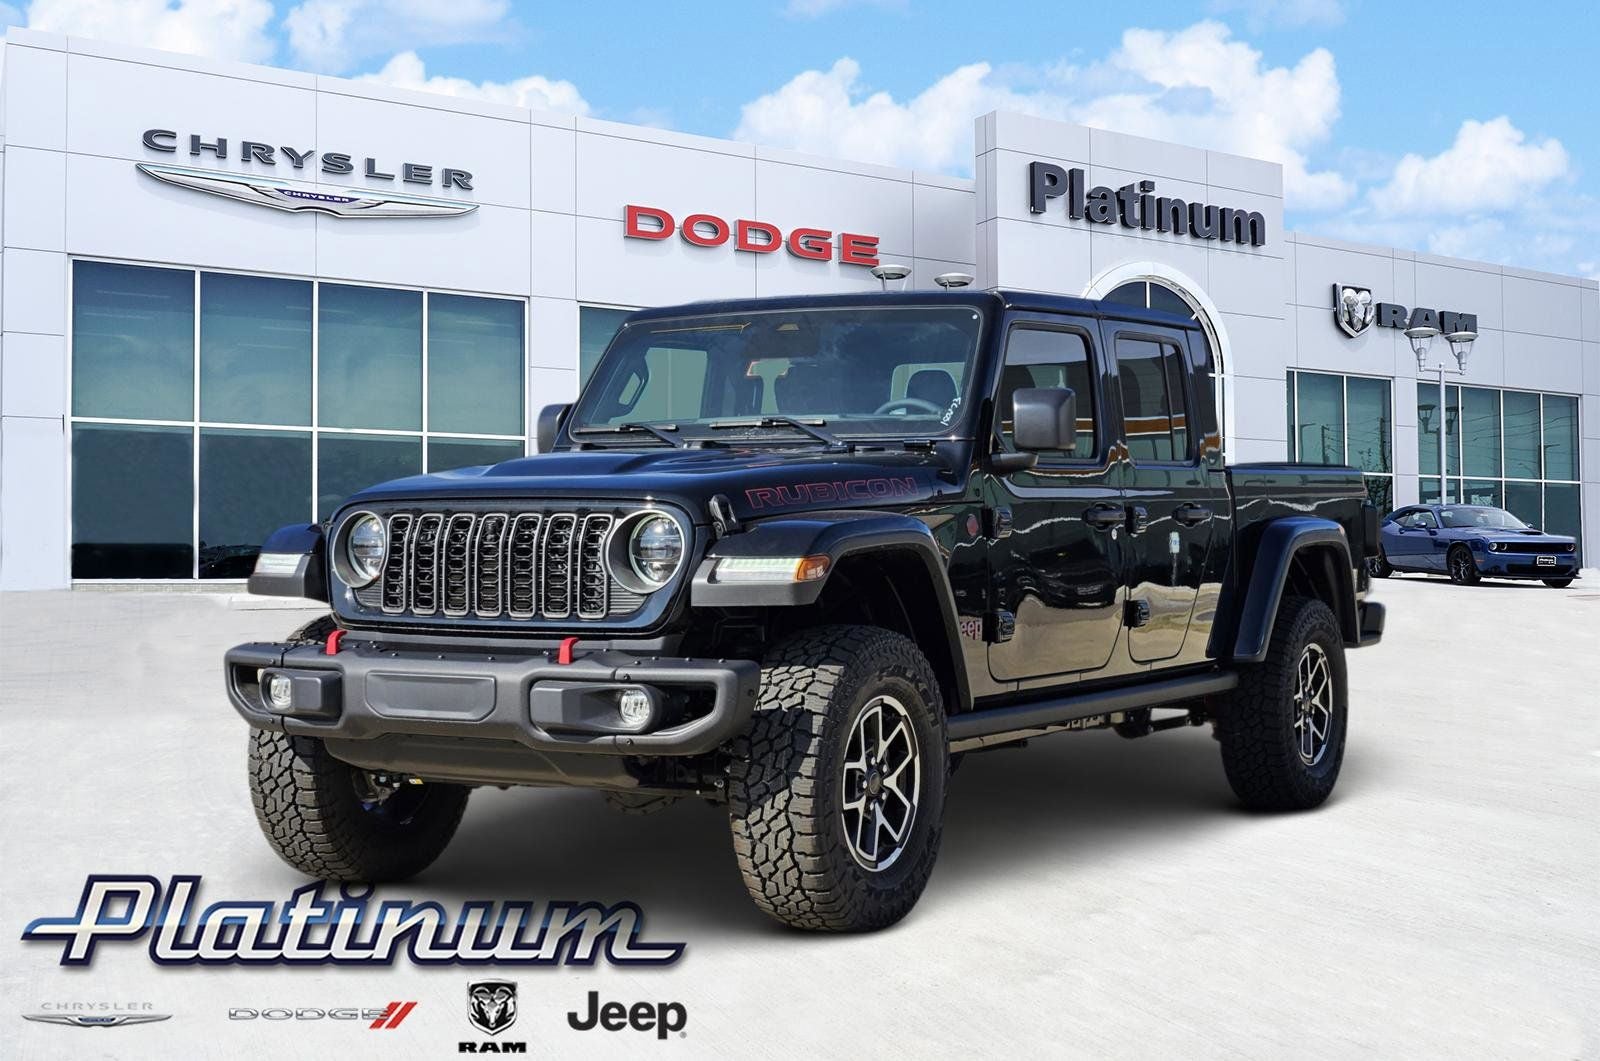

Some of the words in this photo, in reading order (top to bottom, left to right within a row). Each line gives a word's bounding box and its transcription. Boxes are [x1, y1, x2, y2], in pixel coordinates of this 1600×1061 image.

[142, 128, 474, 190] CHRYSLER
[283, 190, 350, 202] CHRYSLER
[1029, 160, 1266, 248] Platinum
[623, 204, 880, 267] DODGE
[1376, 302, 1478, 334] RAM
[745, 477, 920, 509] RUBICON
